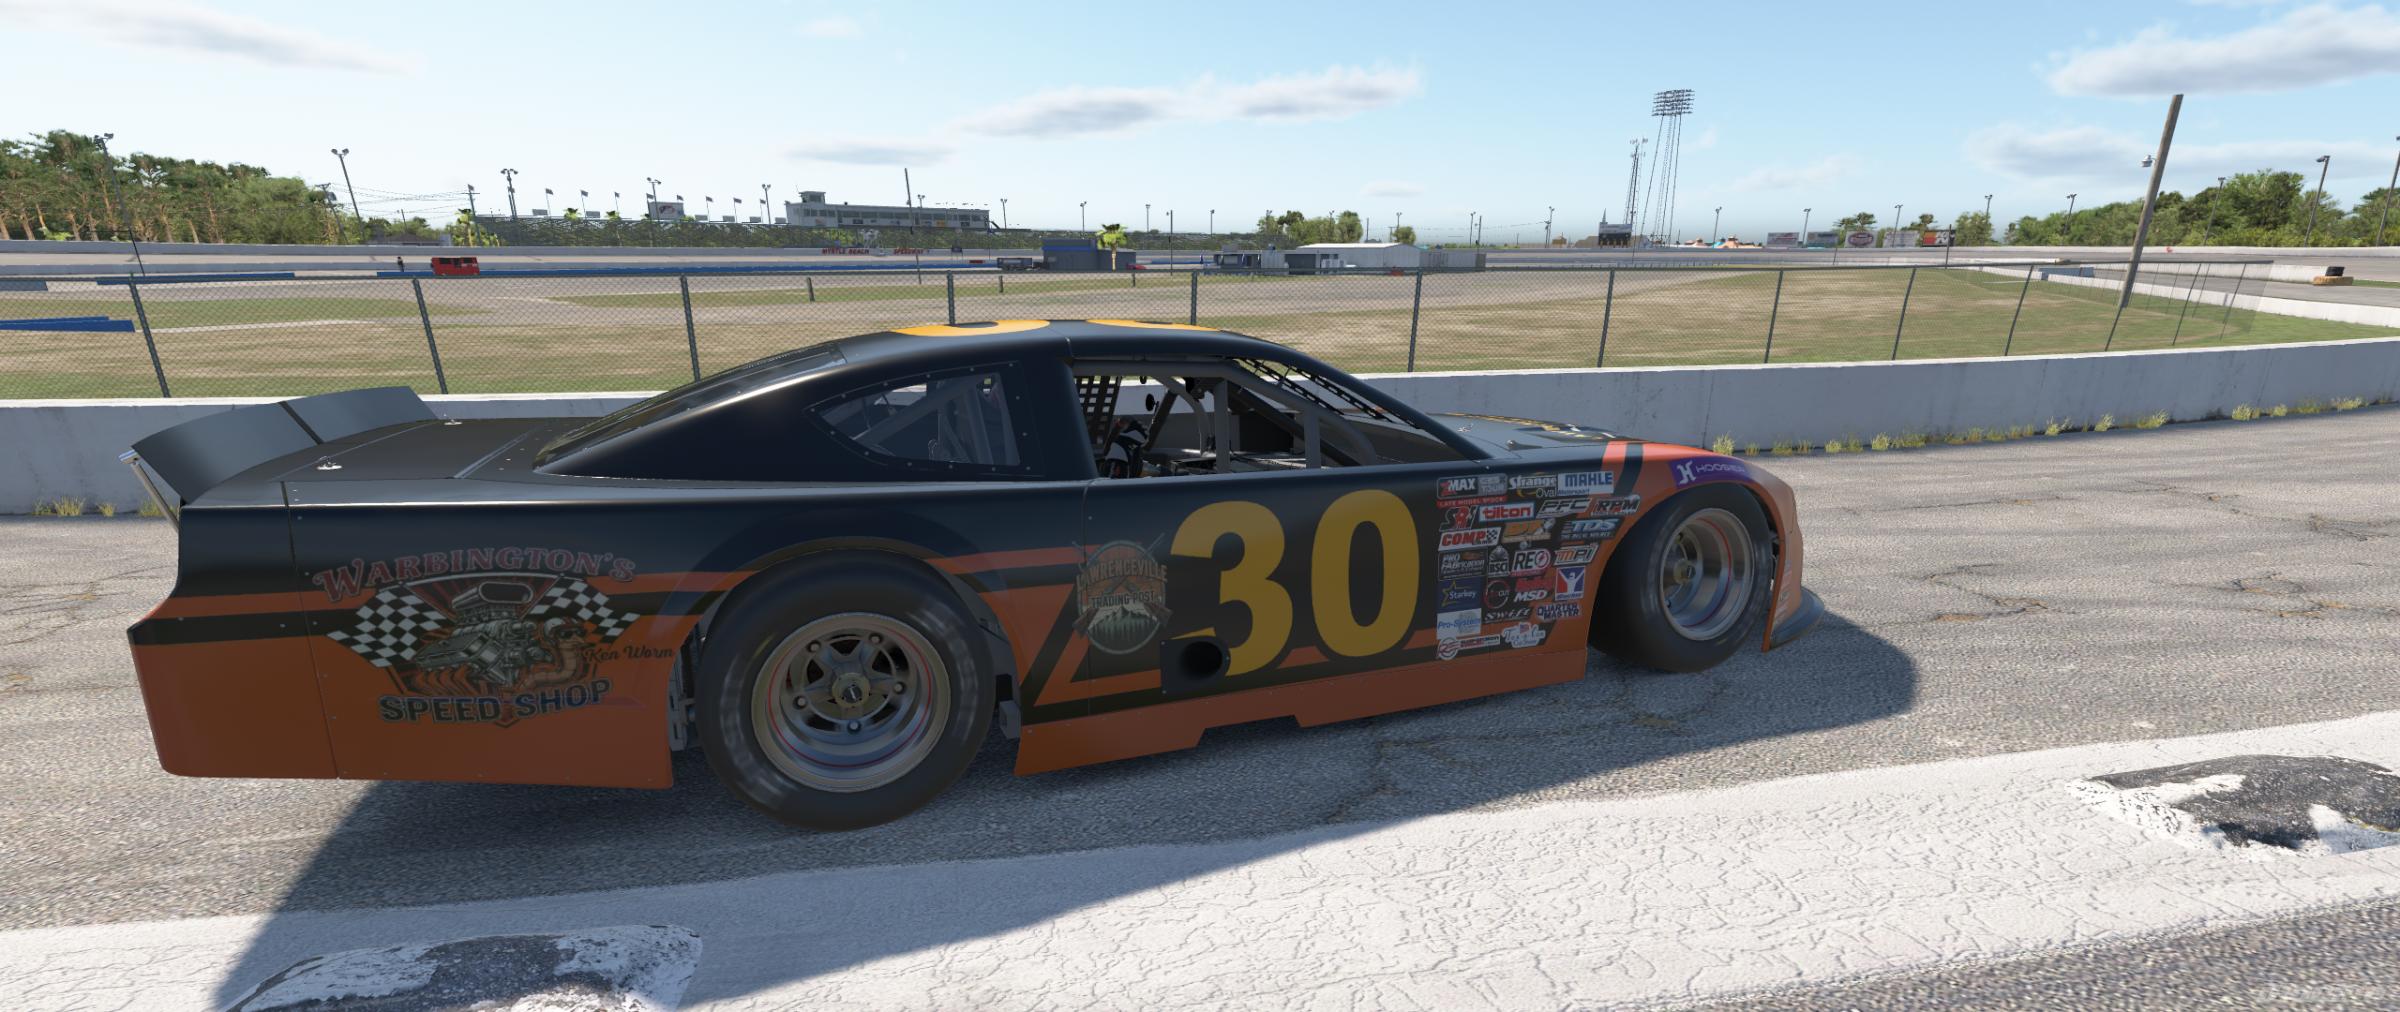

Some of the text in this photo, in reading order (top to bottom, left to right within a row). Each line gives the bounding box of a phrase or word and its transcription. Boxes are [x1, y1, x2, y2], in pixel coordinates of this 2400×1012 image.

[1565, 472, 1613, 488] MAHLE
[1535, 487, 1557, 498] Oval
[1441, 530, 1487, 547] COMP
[312, 547, 636, 602] WARBINGTON'S
[1171, 489, 1420, 677] 30
[1133, 590, 1155, 604] POST
[1513, 589, 1548, 603] MSD
[379, 678, 612, 722] SPEED SHOP
